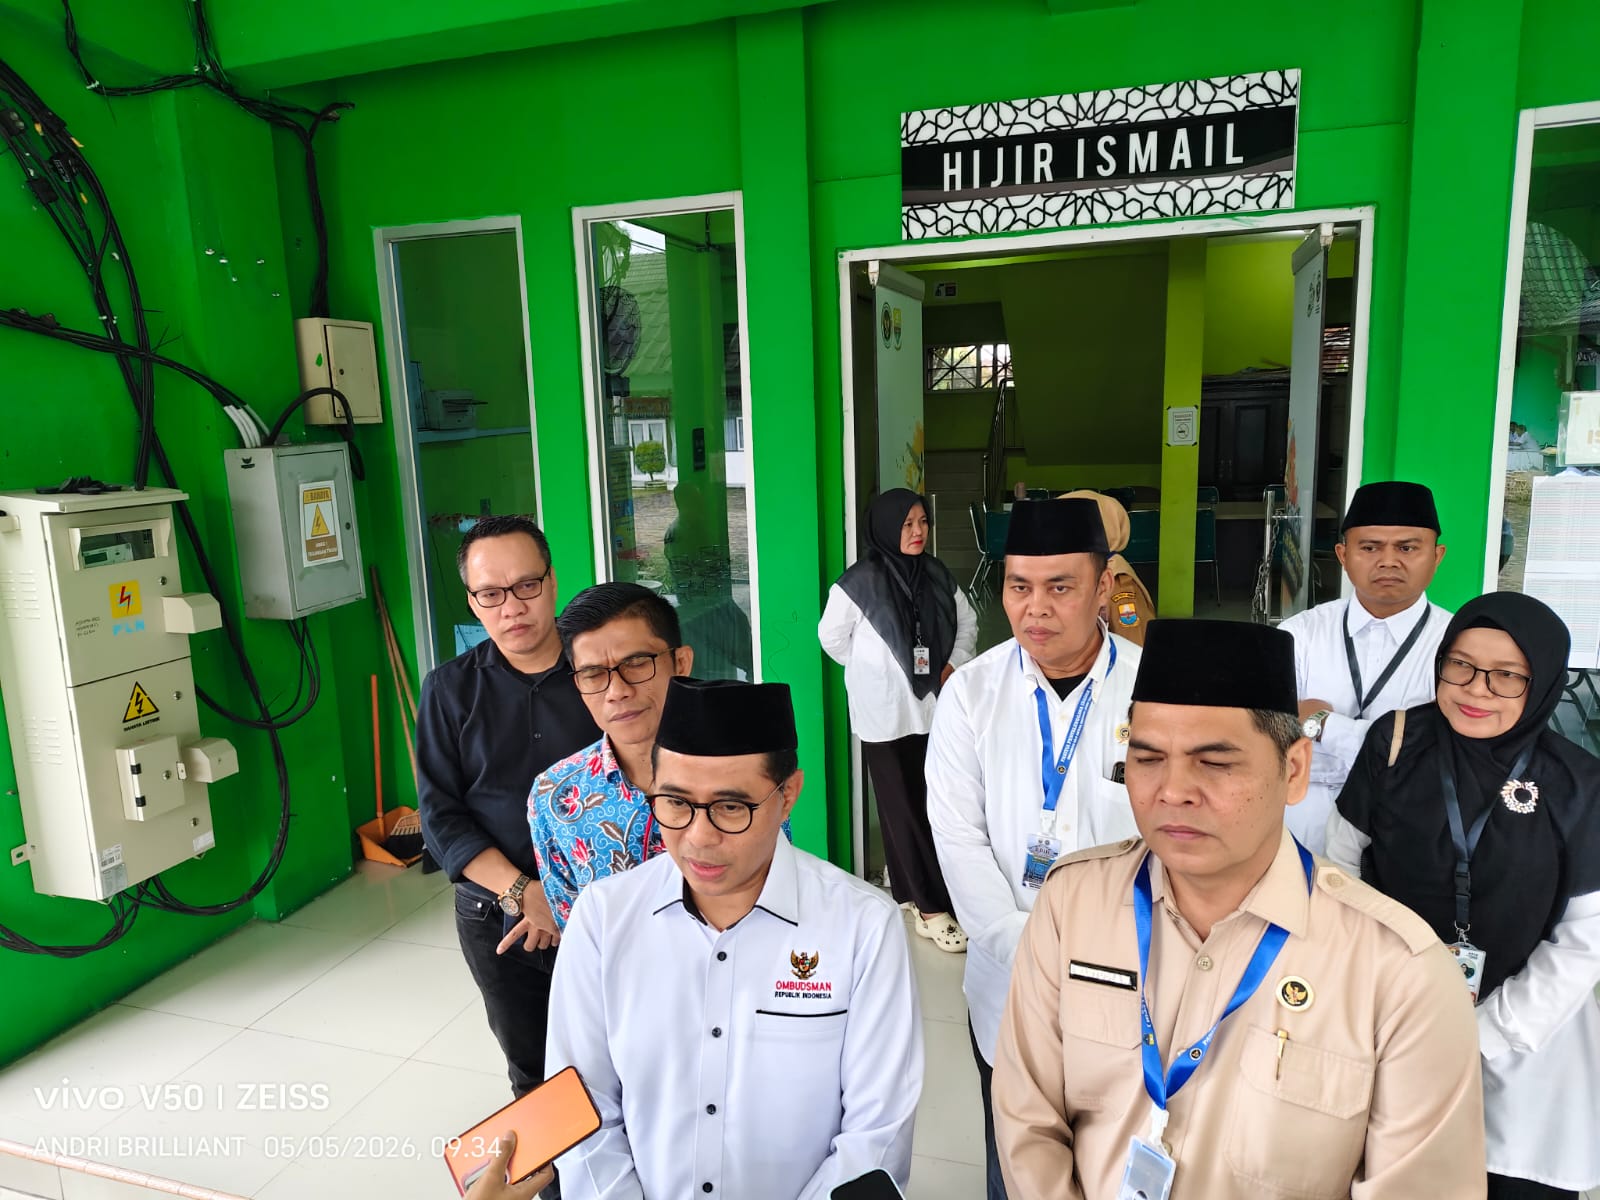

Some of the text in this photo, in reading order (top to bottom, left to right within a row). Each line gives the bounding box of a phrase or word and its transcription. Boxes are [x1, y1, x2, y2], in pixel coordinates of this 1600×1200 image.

[942, 122, 1245, 193] HIJIR ISMAIL
[112, 619, 145, 637] PLN
[775, 980, 832, 992] OMBUDSMAN
[774, 991, 832, 1000] REPUBLIK INDONESIA
